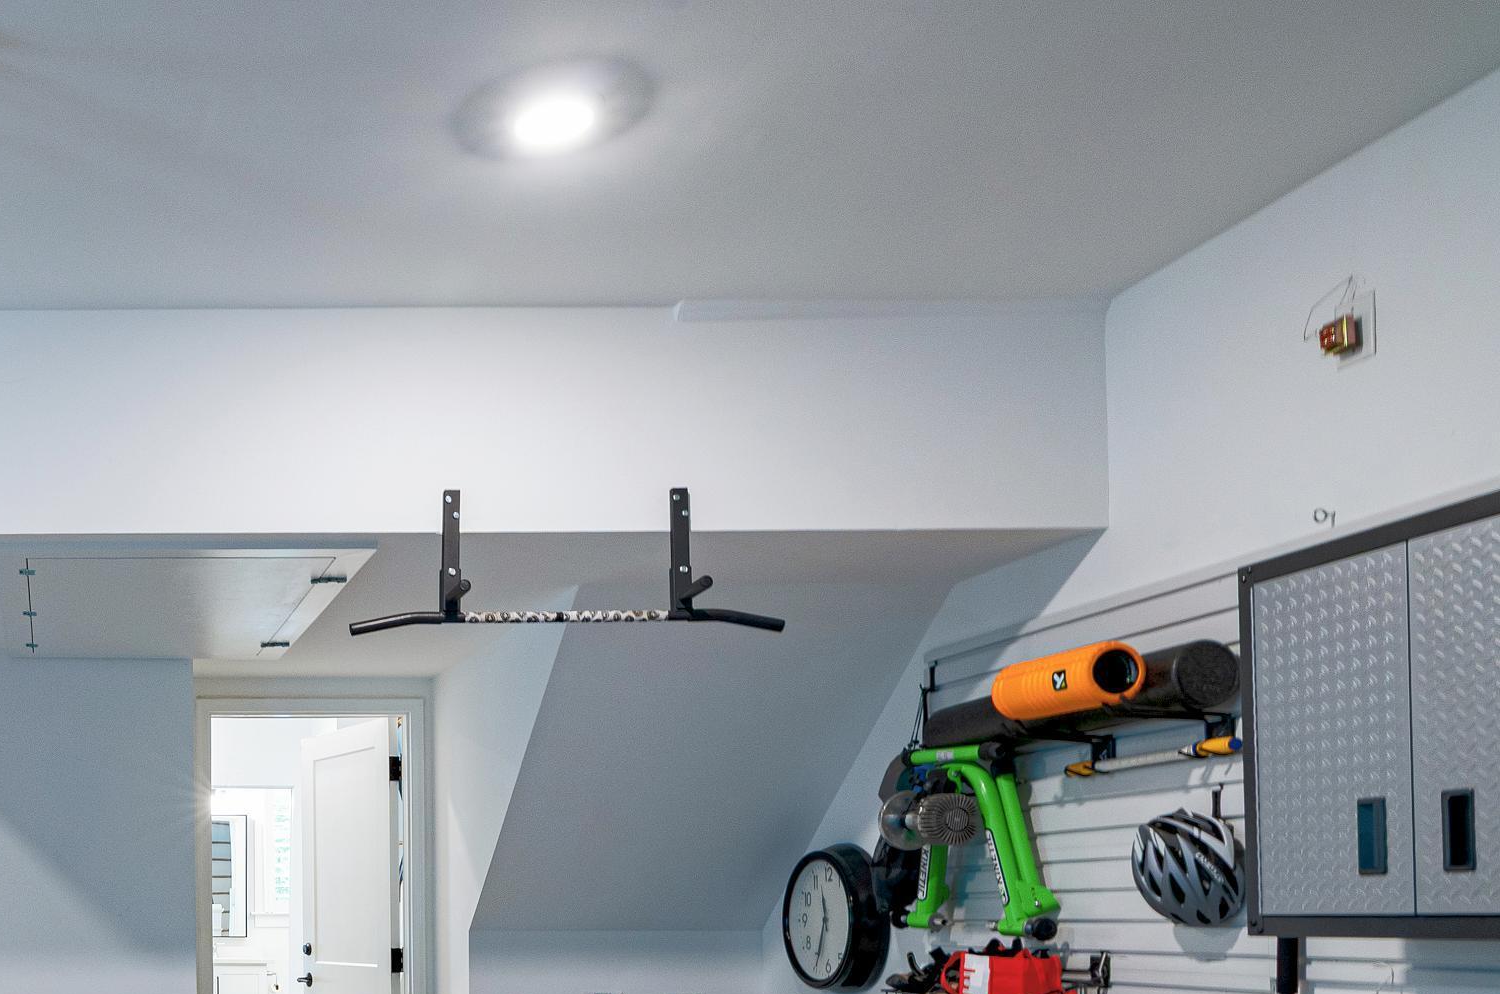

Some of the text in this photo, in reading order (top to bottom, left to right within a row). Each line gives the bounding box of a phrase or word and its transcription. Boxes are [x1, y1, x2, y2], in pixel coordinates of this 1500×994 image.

[824, 866, 834, 882] 12
[813, 875, 819, 889] 11
[804, 892, 812, 907] 10
[801, 913, 808, 928] 9
[805, 935, 812, 950] 8
[825, 959, 832, 973] 6
